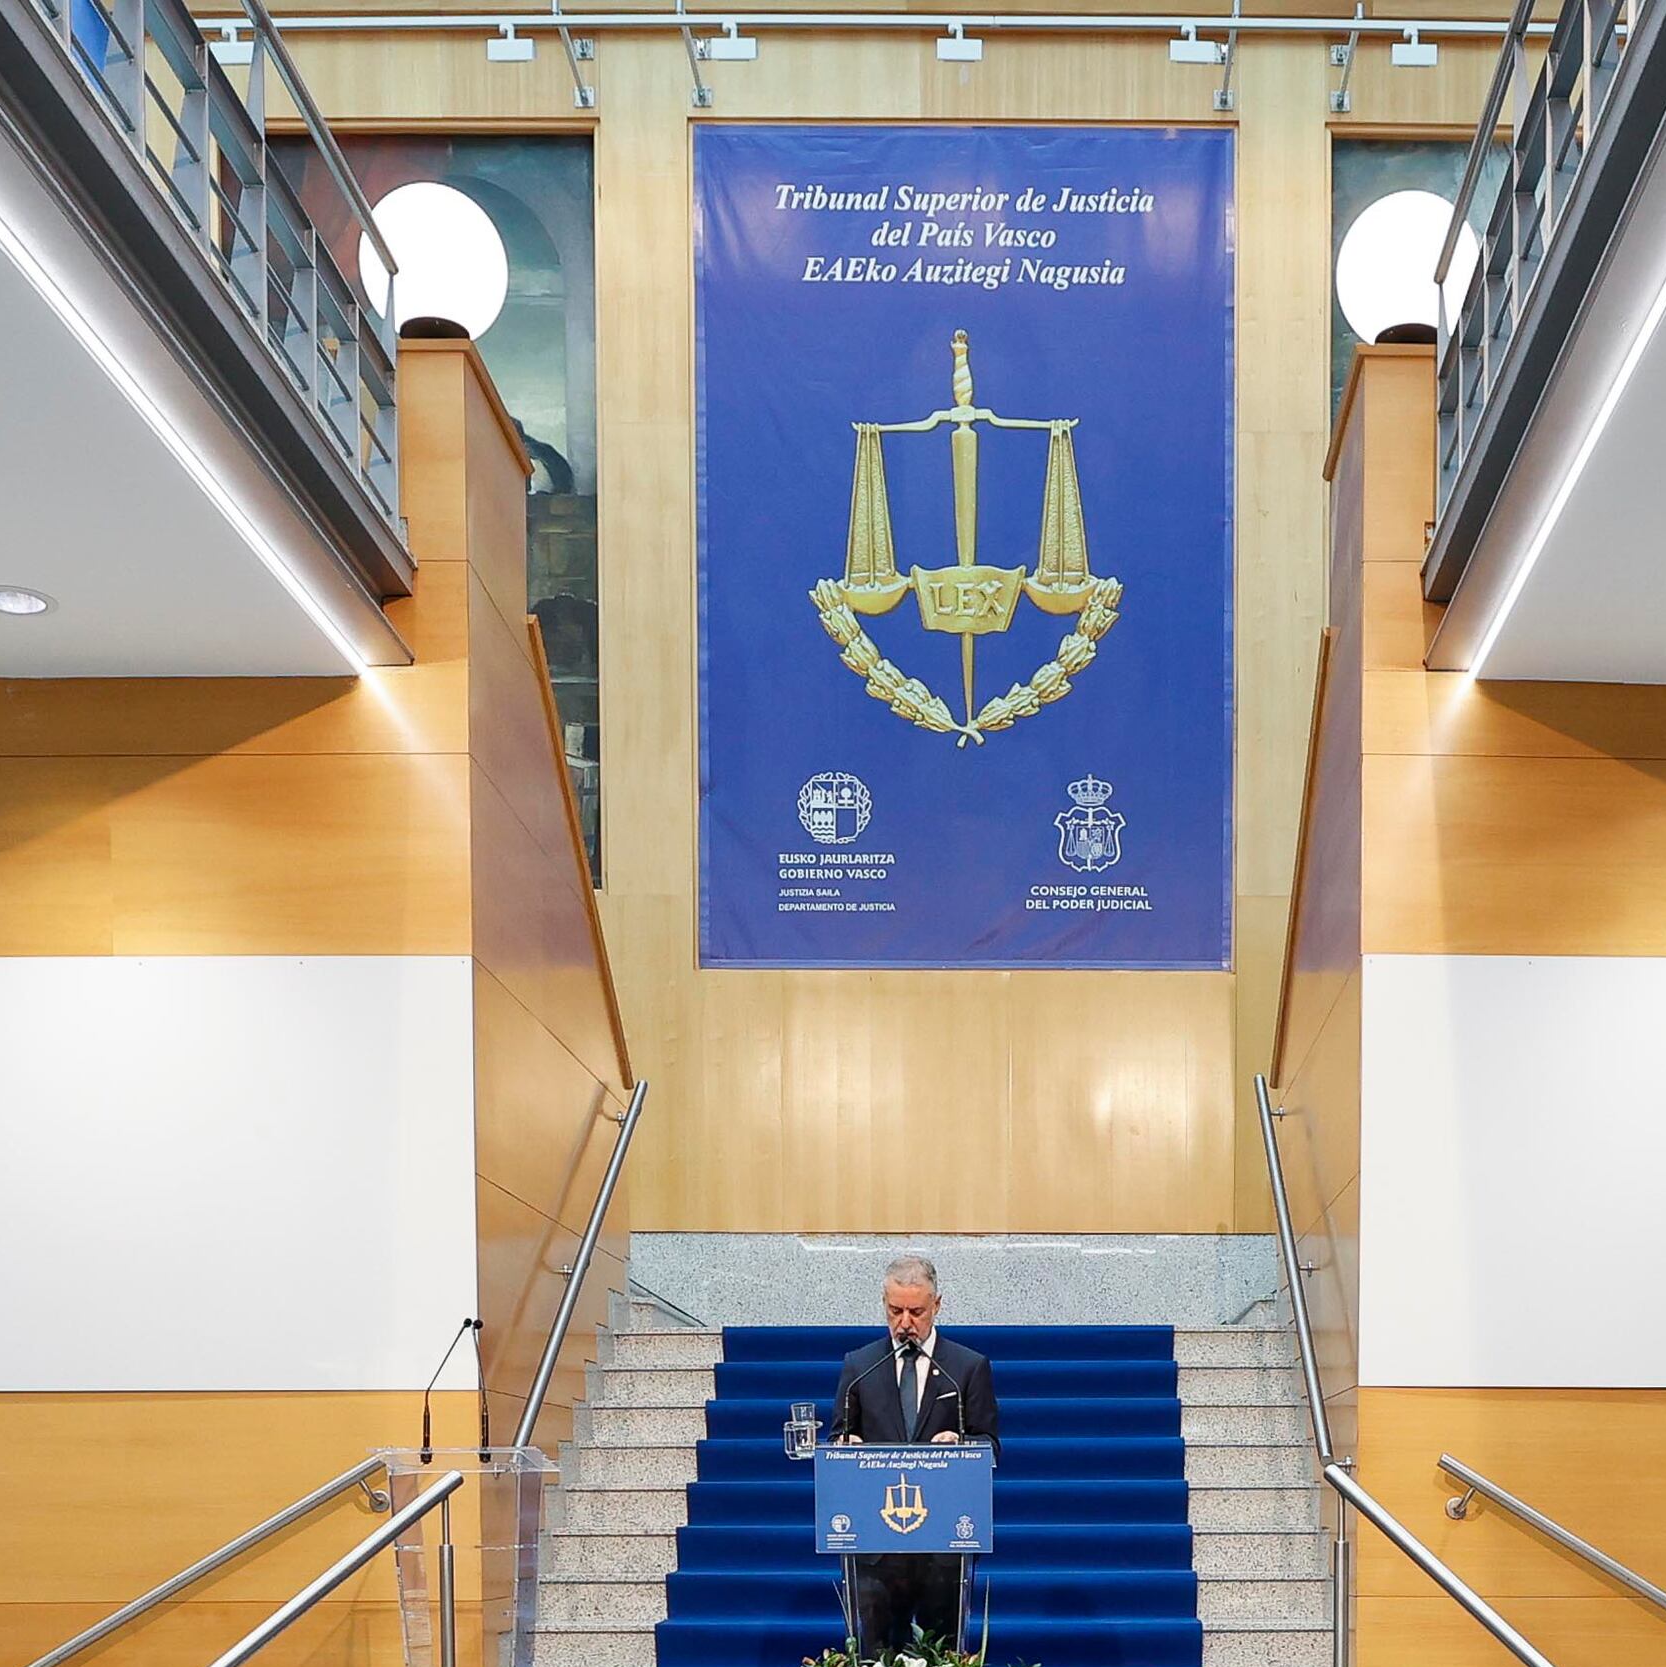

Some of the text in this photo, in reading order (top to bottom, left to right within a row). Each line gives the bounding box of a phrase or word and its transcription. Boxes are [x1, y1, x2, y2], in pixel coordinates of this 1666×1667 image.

[774, 184, 1154, 217] Tribunal Superior de Justicia
[871, 220, 1056, 248] del País Vasco
[802, 257, 1126, 291] EAEko Auzitegi Nagusia
[929, 579, 1005, 617] LEX
[778, 853, 895, 866] EUSKO JAURLARITZA
[778, 868, 887, 880] GOBIERNO VASCO
[778, 888, 840, 897] JUSTIZIA SAILA
[1030, 885, 1148, 898] CONSEJO GENERAL
[778, 902, 896, 912] DEPARTAMENTO DE JUSTICIA
[1025, 899, 1153, 912] DEL PODER JUDICIAL
